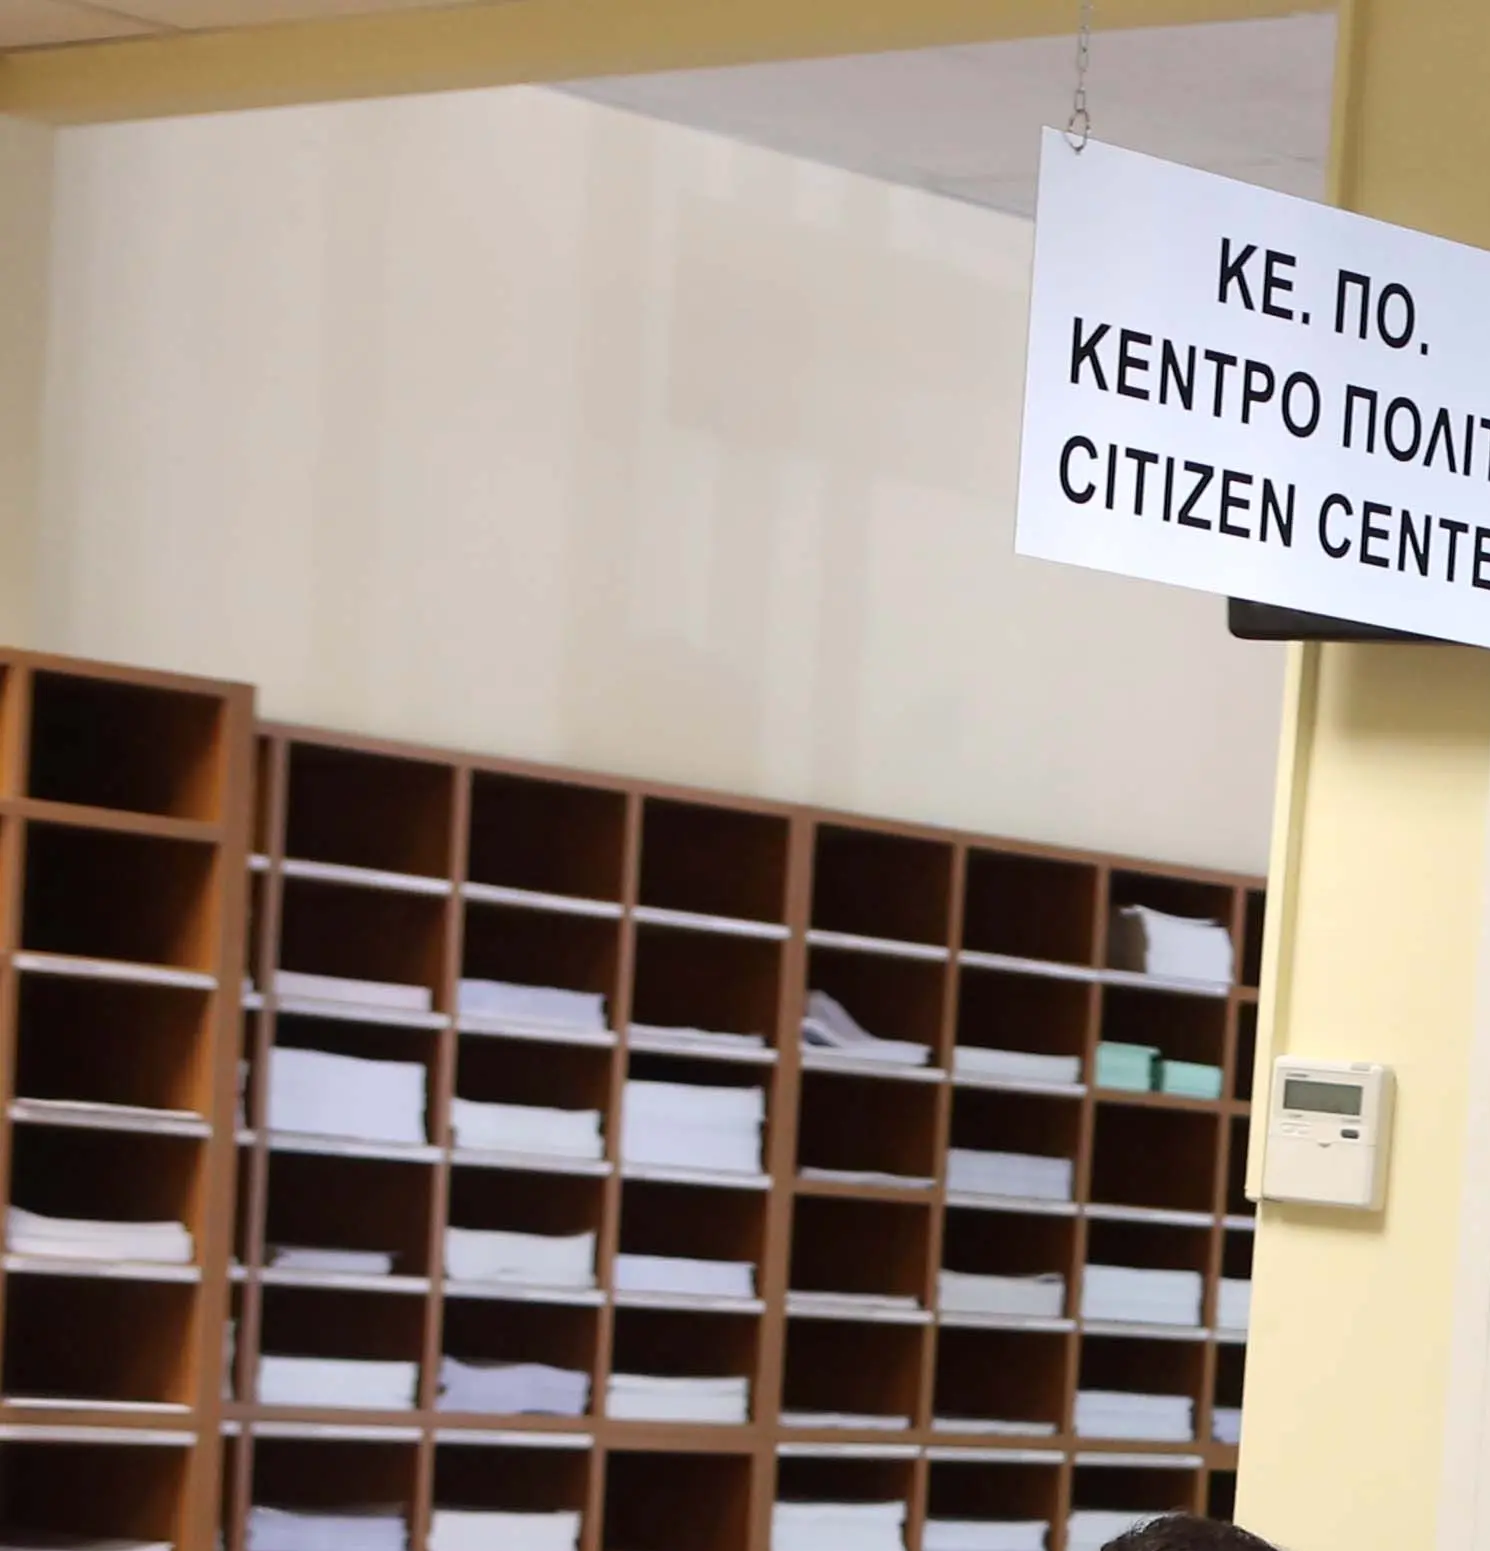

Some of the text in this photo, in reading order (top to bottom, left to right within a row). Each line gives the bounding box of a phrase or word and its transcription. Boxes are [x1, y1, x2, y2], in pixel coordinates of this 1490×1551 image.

[1217, 236, 1430, 356] ΚΕ. ΠΟ.
[1069, 316, 1322, 439] ΚΕΝΤΡΟ
[1058, 434, 1296, 548] CITIZEN
